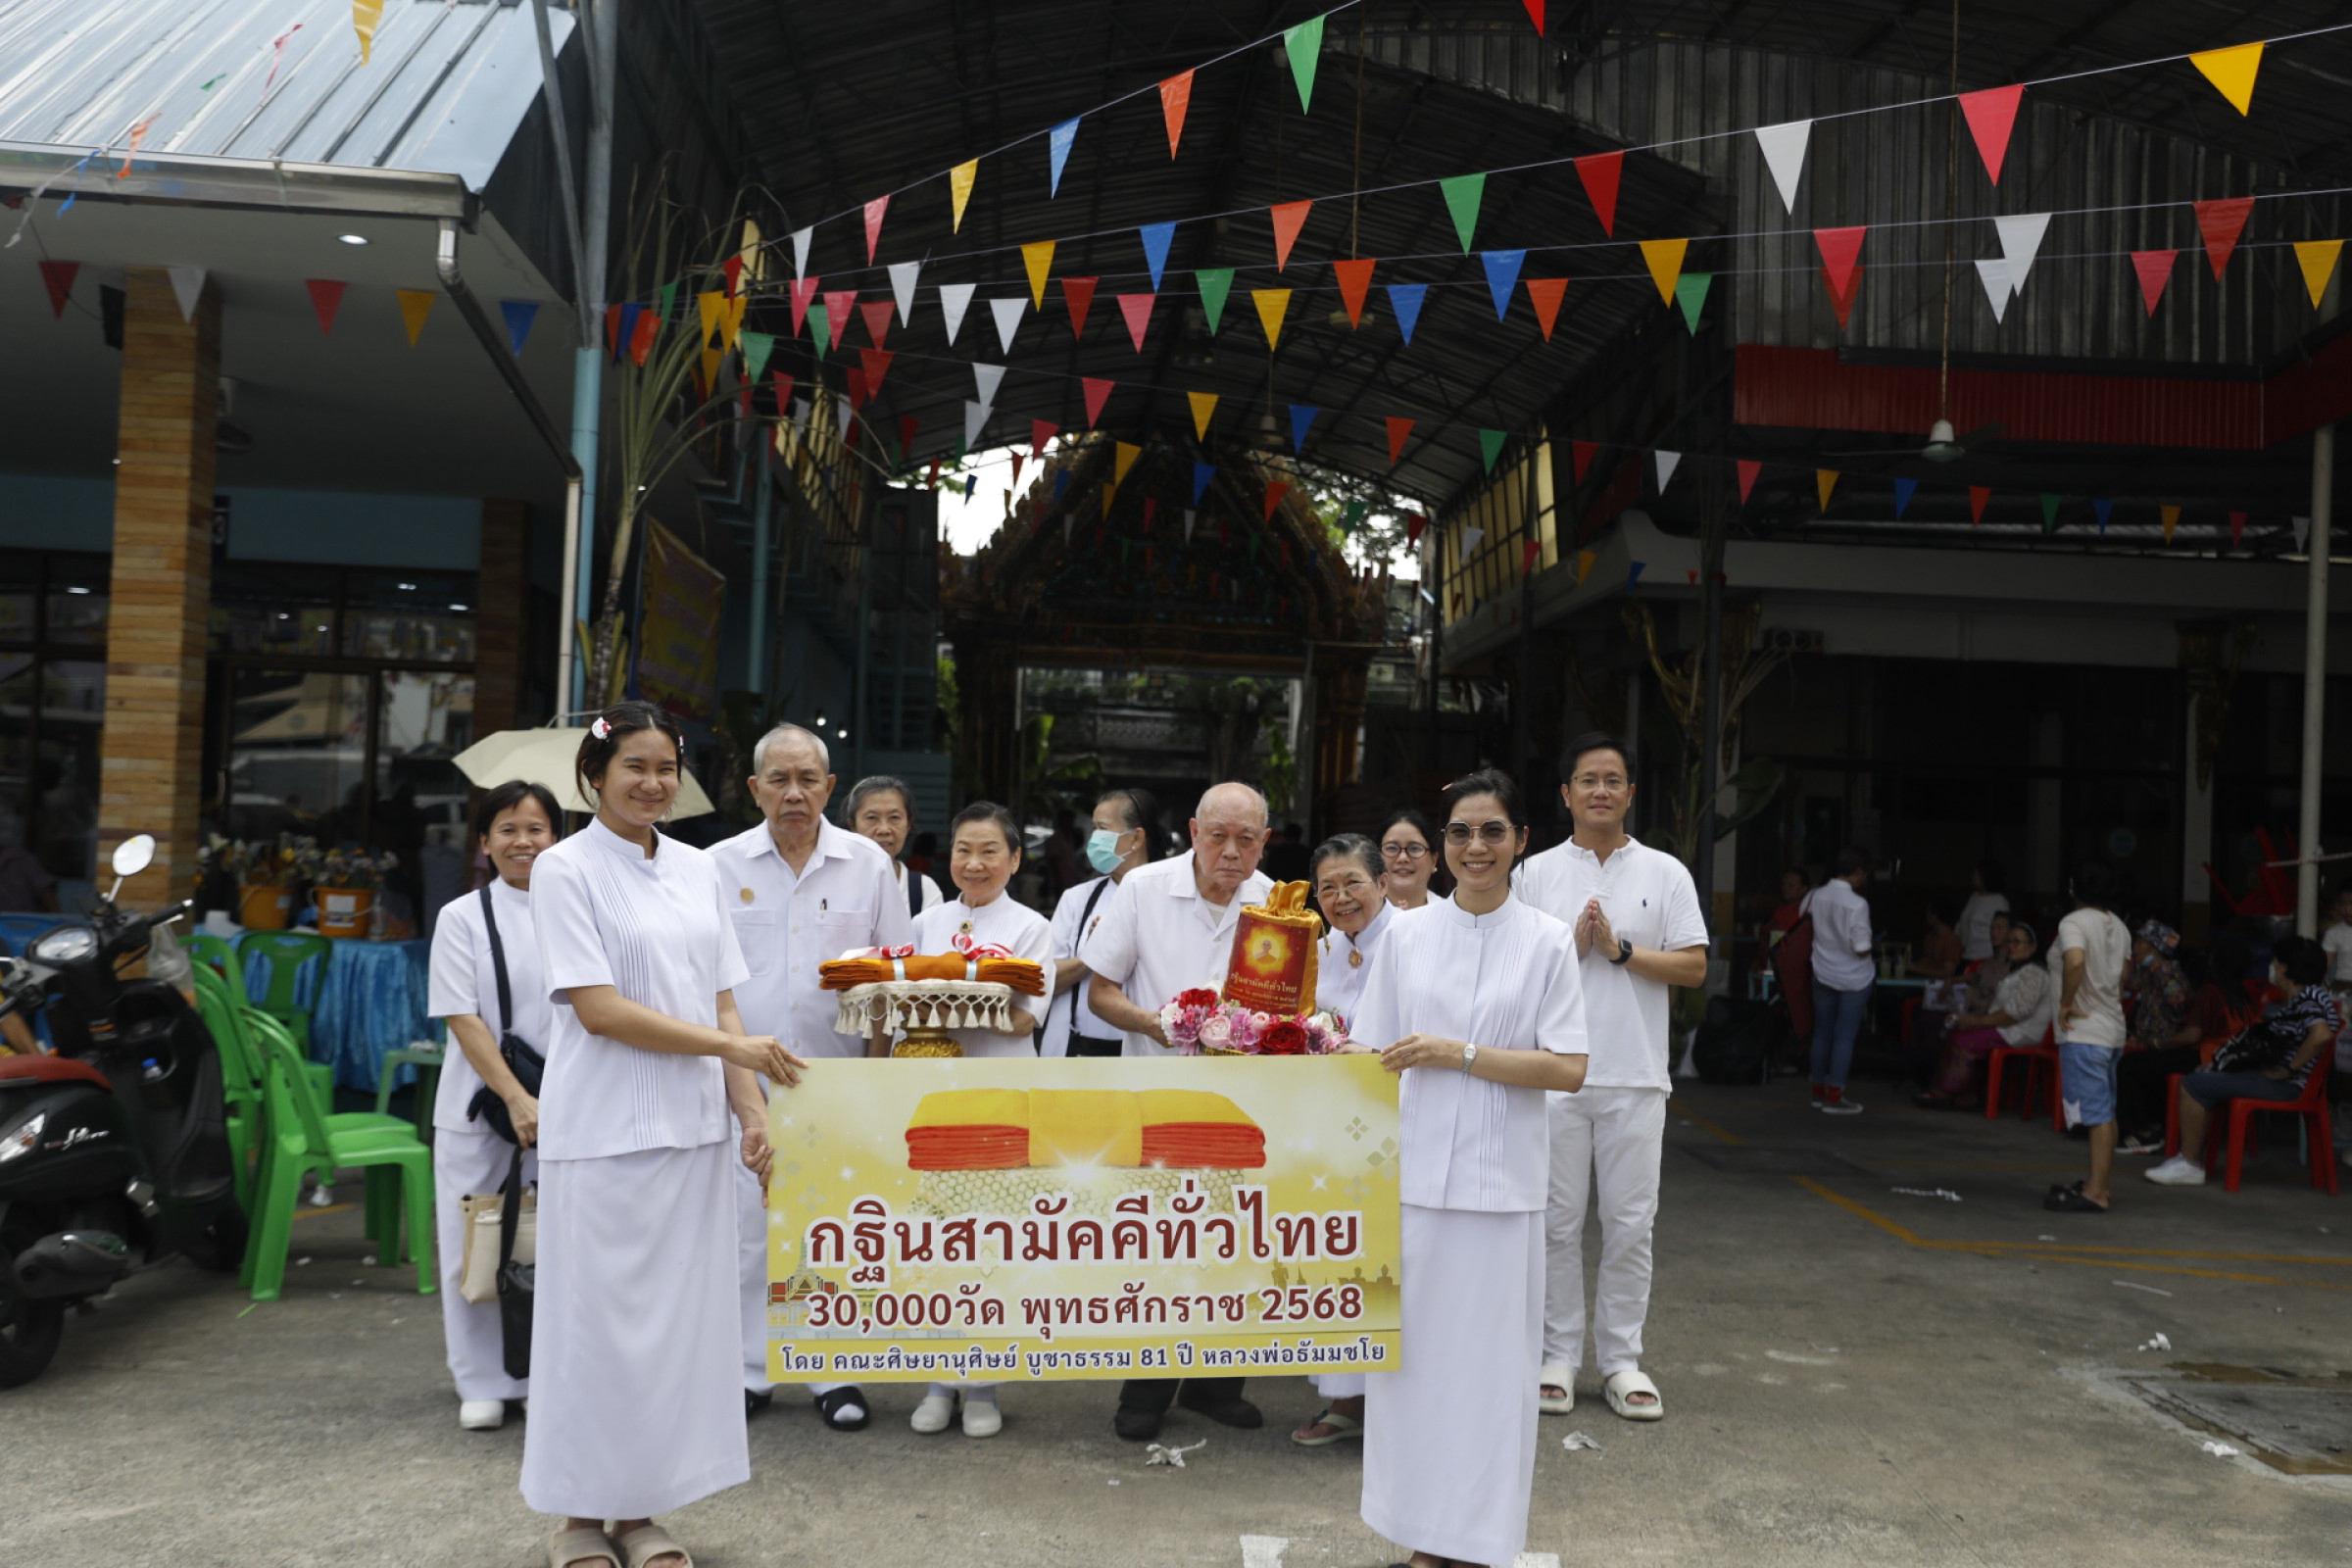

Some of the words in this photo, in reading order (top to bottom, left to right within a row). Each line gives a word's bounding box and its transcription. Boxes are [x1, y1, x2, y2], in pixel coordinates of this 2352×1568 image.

[809, 1179, 1358, 1283] กฐินสามัคคีทั่วไทย
[1020, 1282, 1245, 1340] พุทธศักราช
[1261, 1287, 1362, 1321] 2568
[781, 1346, 824, 1370] โดย
[834, 1344, 1018, 1376] คณะศิษยานุศิษย์
[1026, 1350, 1131, 1376] บูชาธรรม
[1141, 1348, 1167, 1366] 81
[1176, 1342, 1193, 1366] ปี
[1201, 1337, 1385, 1365] หลวงพ่อธัมมชโย
